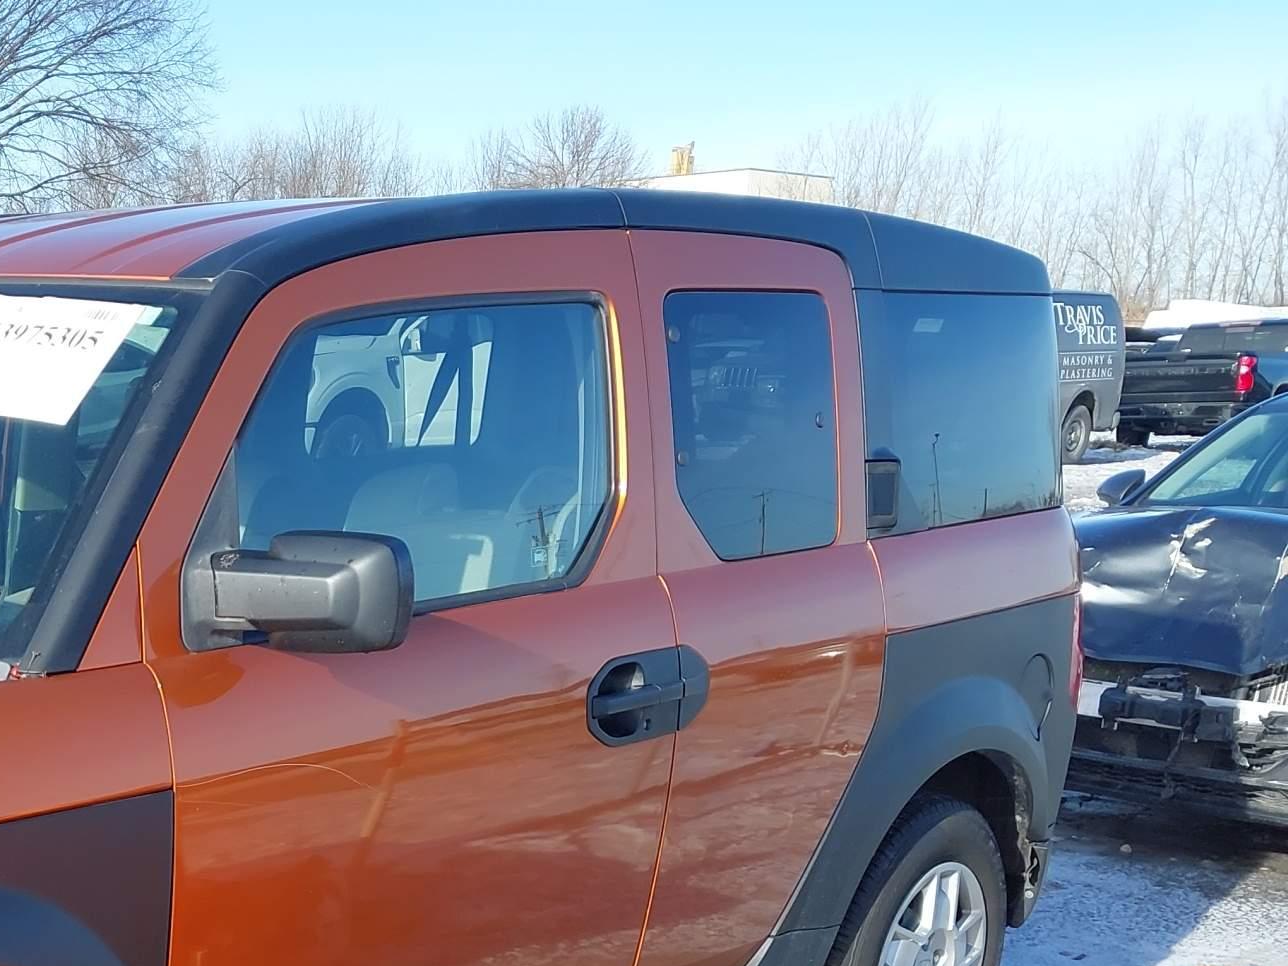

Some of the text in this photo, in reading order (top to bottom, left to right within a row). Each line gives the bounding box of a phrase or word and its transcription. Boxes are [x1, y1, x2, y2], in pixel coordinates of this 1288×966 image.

[1052, 302, 1105, 326] TRAVIS
[1078, 325, 1117, 345] PRICE
[1062, 355, 1105, 366] MASONRY
[1060, 367, 1113, 379] PLASTERING
